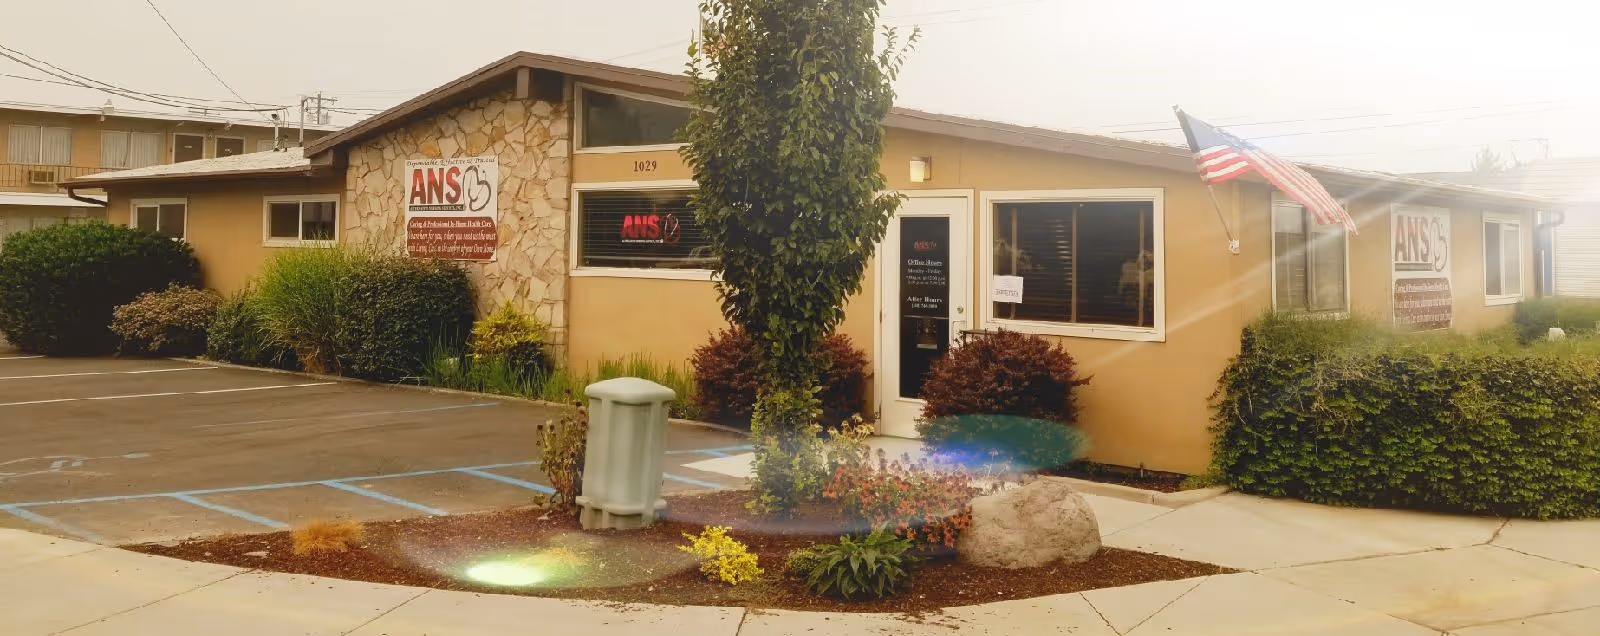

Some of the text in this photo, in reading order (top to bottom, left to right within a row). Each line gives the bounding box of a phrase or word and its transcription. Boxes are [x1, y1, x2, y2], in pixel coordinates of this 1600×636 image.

[633, 160, 657, 172] 1029
[409, 166, 461, 204] ANS
[621, 215, 660, 237] ANS
[1394, 215, 1430, 262] ANS
